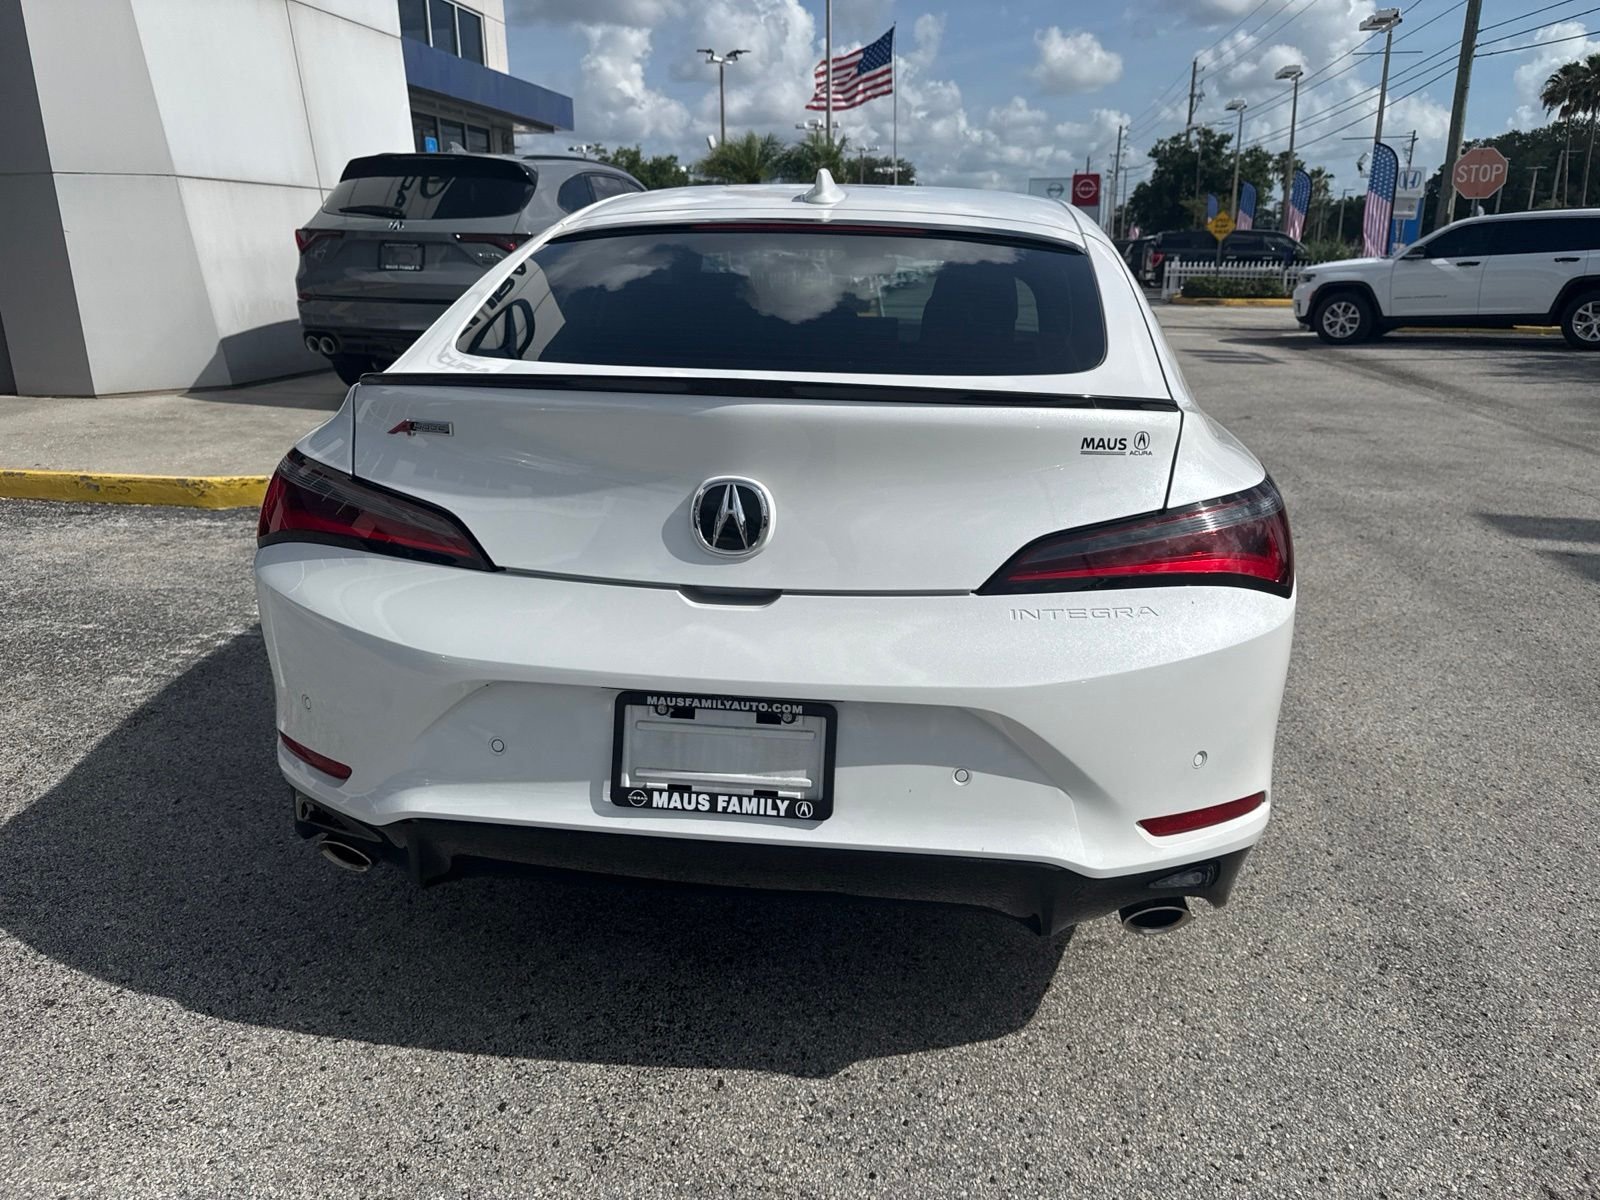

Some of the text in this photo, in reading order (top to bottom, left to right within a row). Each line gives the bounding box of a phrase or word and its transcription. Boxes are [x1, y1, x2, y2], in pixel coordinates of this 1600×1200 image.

[1456, 163, 1504, 183] STOP
[1080, 437, 1127, 451] MAUS
[1009, 606, 1159, 621] INTEGRA
[646, 695, 803, 715] MAUSFAMILYAUTO.COM
[652, 791, 790, 817] MAUS FAMILY
